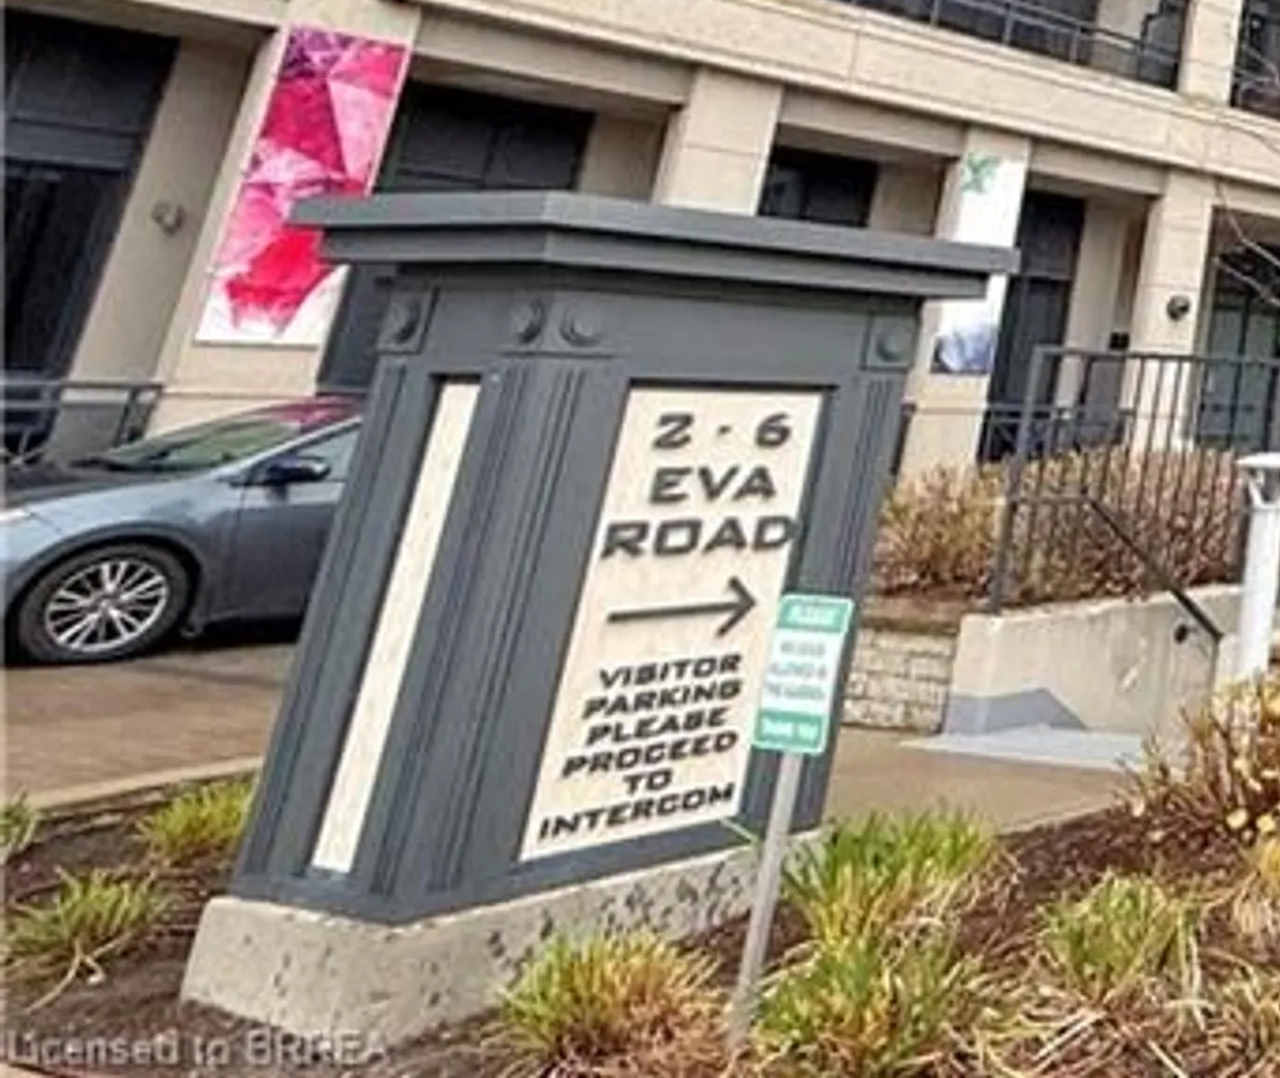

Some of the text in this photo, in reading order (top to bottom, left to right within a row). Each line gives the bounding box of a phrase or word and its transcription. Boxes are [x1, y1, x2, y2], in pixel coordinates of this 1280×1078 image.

[652, 413, 695, 450] 2
[755, 413, 792, 448] 6
[650, 465, 777, 504] EVA
[600, 516, 800, 559] ROAD
[599, 653, 742, 689] VISITOR
[582, 680, 742, 720] PARKING
[585, 706, 728, 746] PLEASE
[562, 730, 738, 778] PROCEED
[623, 768, 673, 796] TO
[537, 782, 735, 841] INTERCOM
